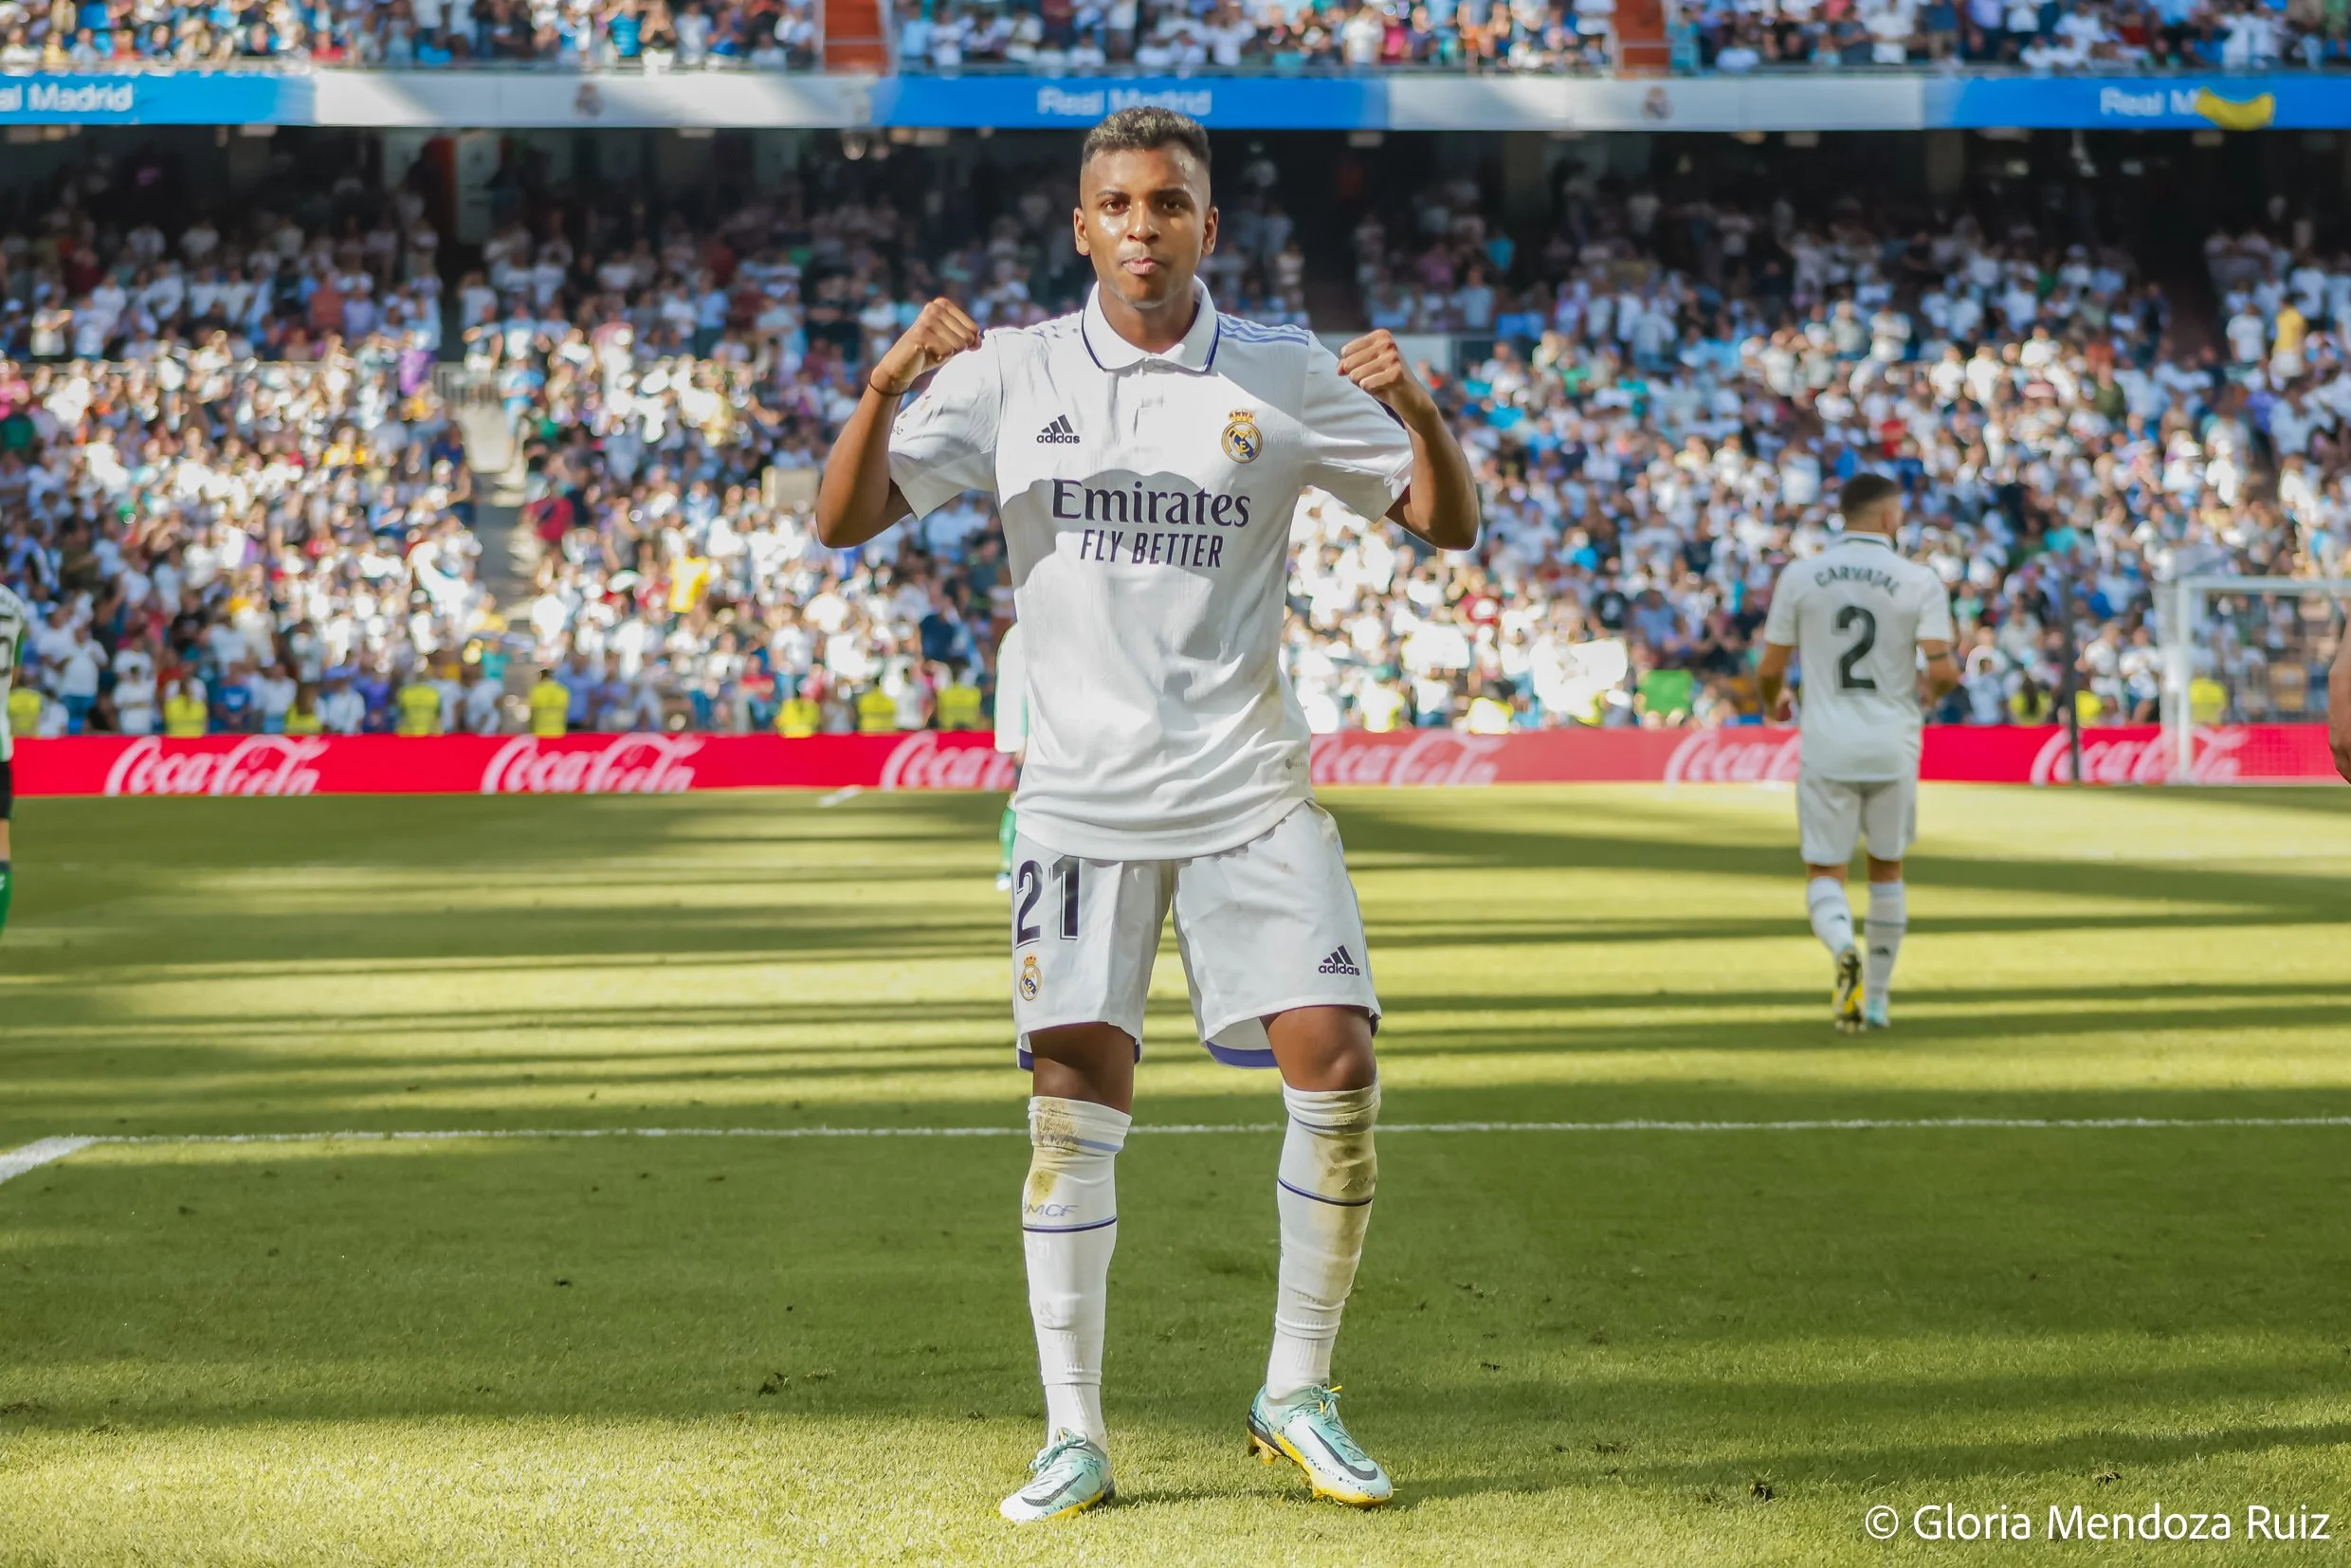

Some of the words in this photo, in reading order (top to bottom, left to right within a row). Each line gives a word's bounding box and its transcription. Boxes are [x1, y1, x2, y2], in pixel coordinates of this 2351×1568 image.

[27, 82, 133, 112] Madrid
[1037, 85, 1105, 116] Real
[2100, 86, 2164, 116] Real
[1036, 432, 1081, 444] adidas
[1052, 478, 1250, 527] Emirates
[1080, 529, 1124, 562] FLY
[1131, 532, 1224, 568] BETTER
[1814, 565, 1900, 597] CARVAJAL
[1832, 605, 1876, 692] 2
[1015, 855, 1081, 949] 21
[1318, 962, 1360, 976] adidas
